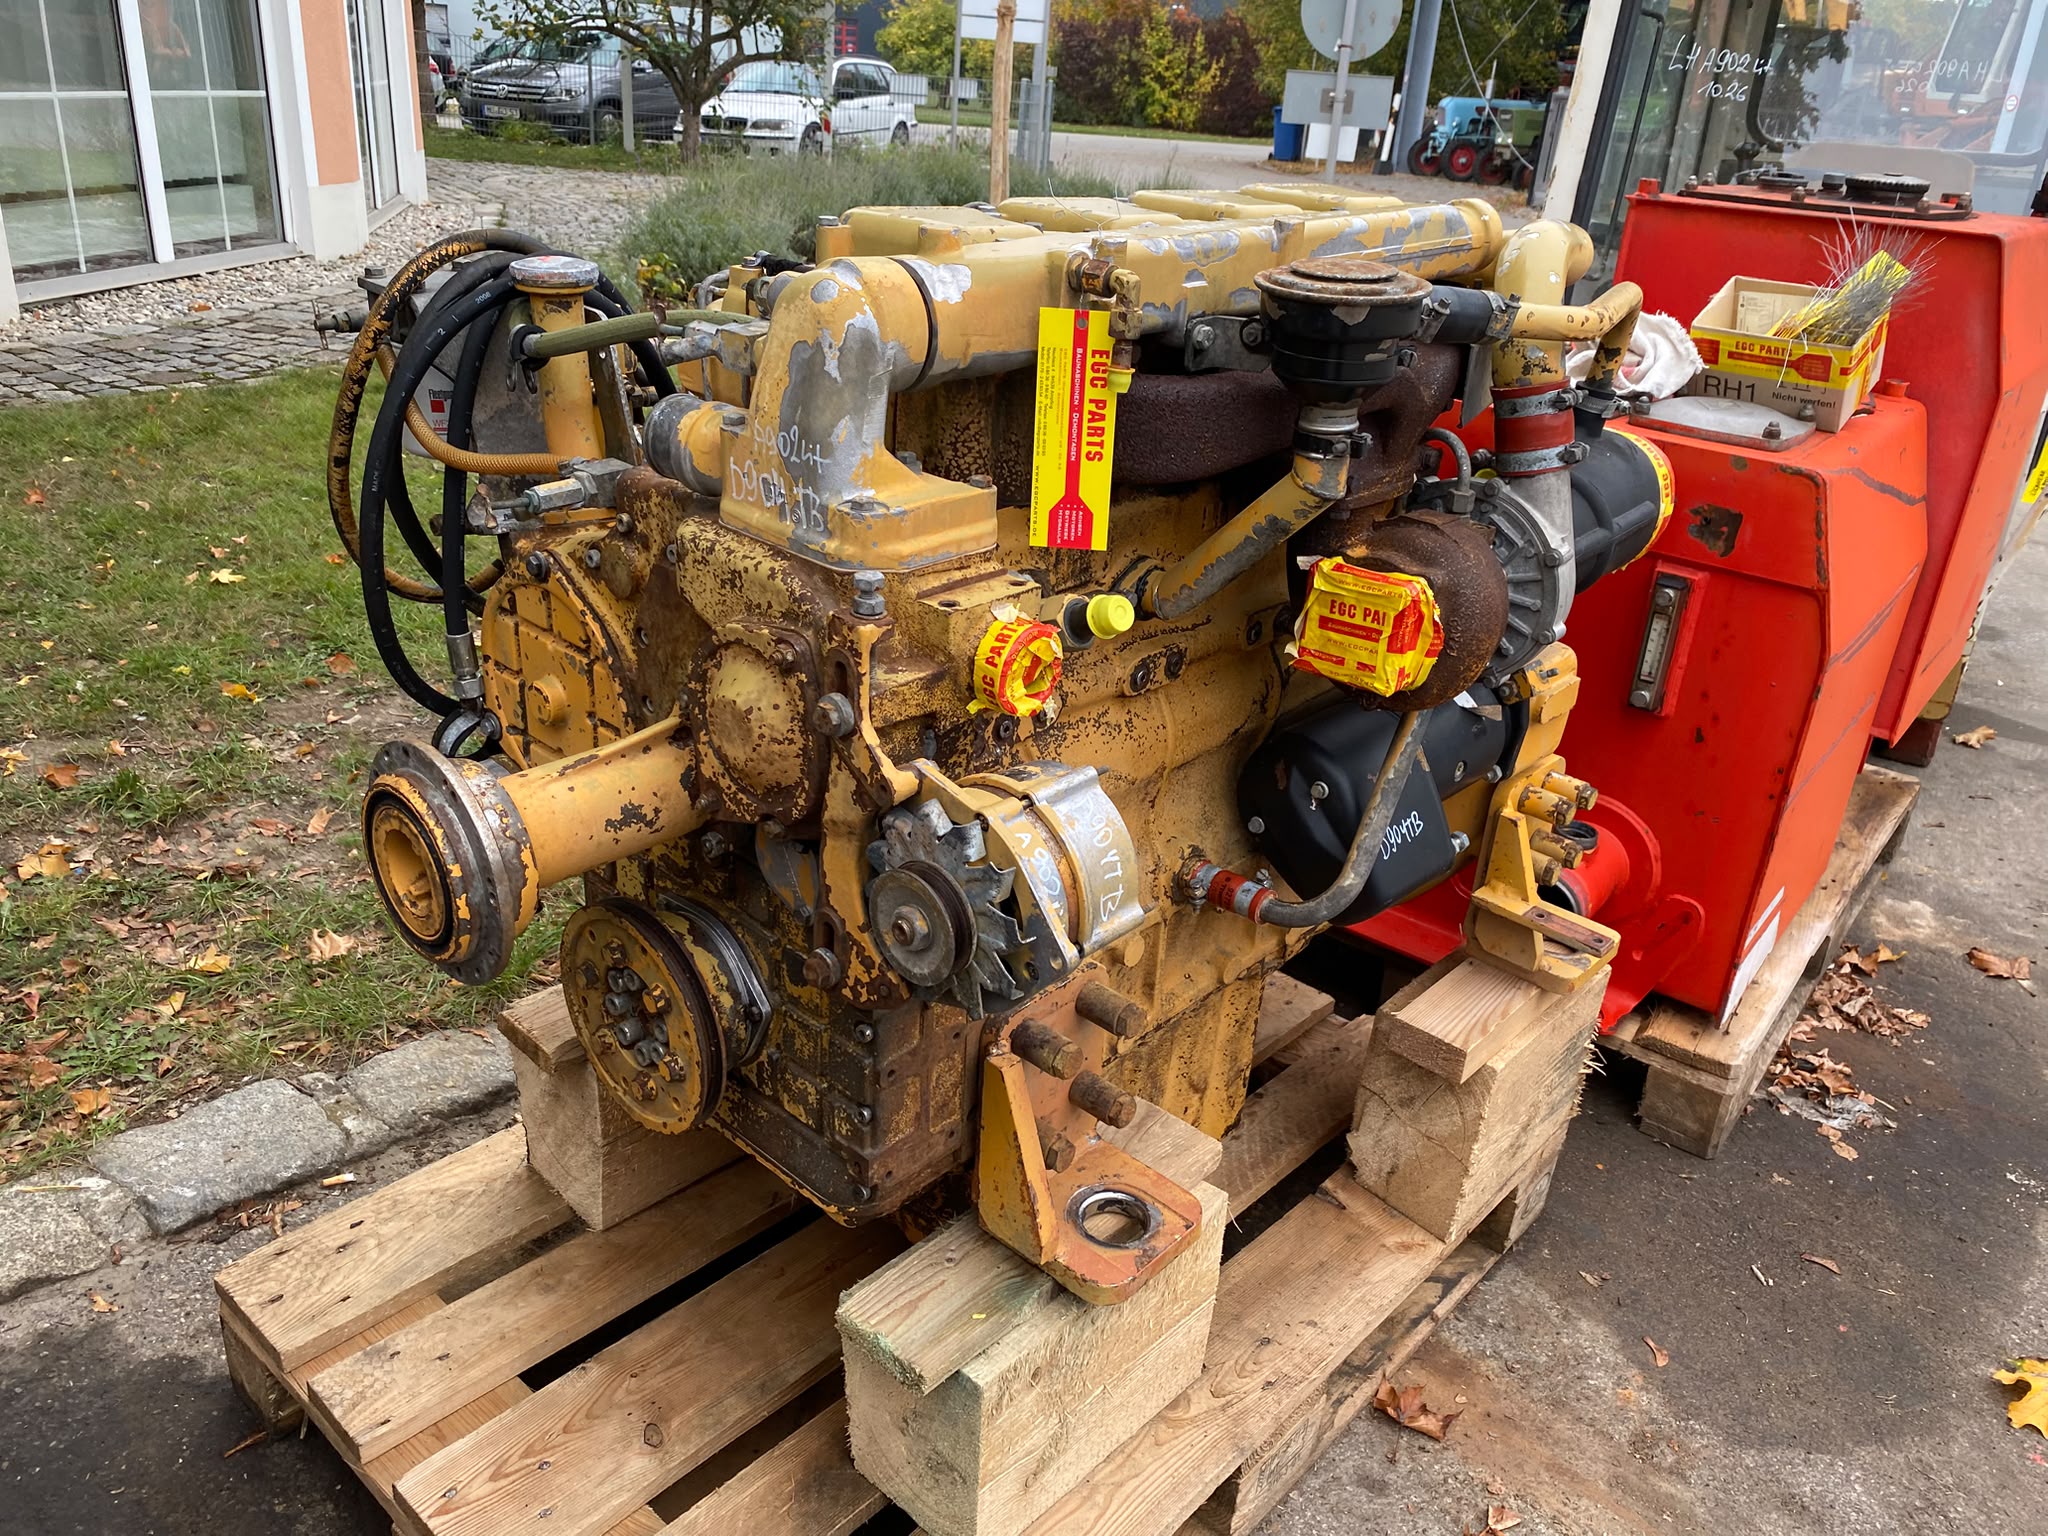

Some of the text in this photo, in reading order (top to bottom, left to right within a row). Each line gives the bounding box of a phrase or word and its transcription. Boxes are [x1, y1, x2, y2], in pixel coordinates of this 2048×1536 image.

[1668, 34, 1701, 71] LH
[1735, 341, 1793, 358] EGC PARTS
[1703, 375, 1756, 402] RH1
[1772, 391, 1836, 409] Nicht werfen!
[1085, 349, 1111, 463] EGC PARTS
[1329, 599, 1357, 619] EGC
[984, 625, 1018, 669] PART
